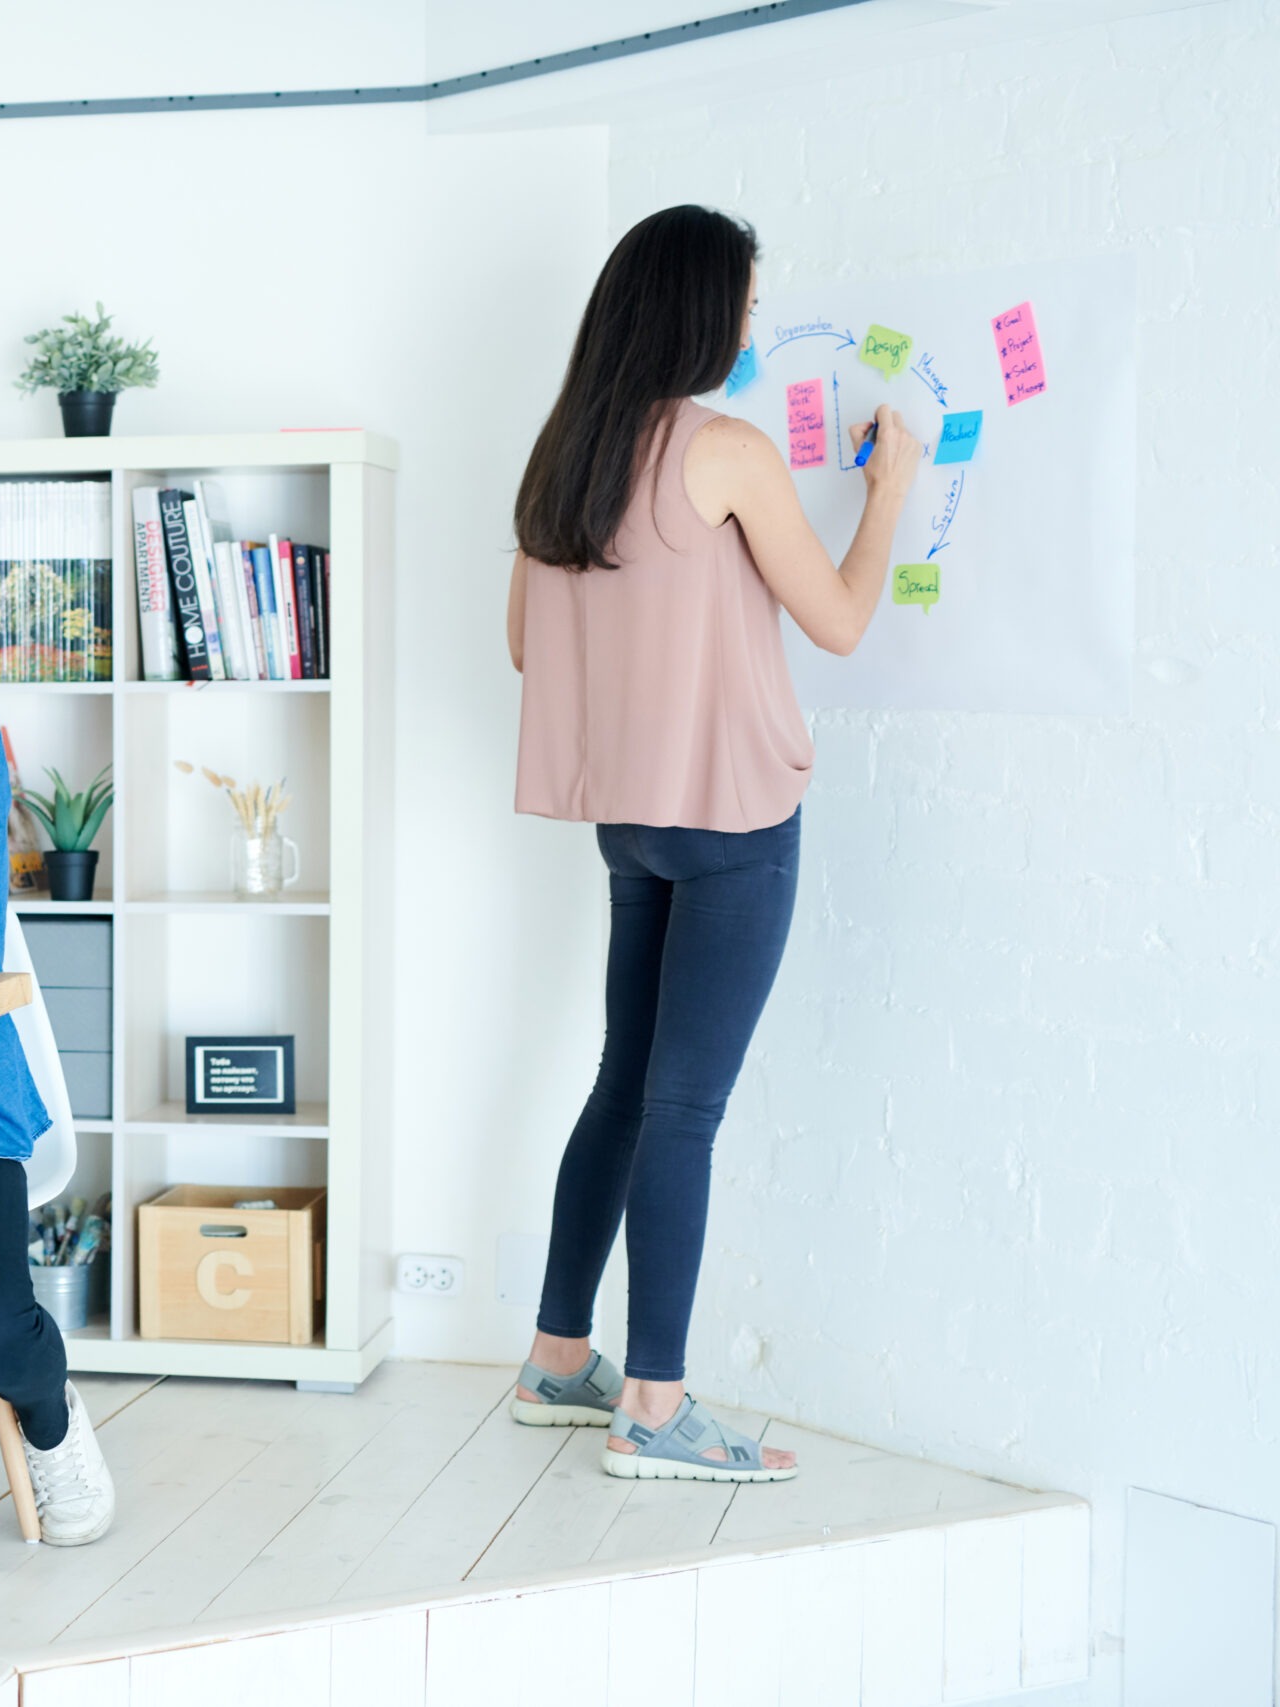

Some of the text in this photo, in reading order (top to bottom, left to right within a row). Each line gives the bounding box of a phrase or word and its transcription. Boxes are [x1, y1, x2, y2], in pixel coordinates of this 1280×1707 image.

[865, 335, 909, 368] Design
[136, 522, 152, 613] APARTMENTS
[145, 520, 166, 613] DESIGNER
[162, 500, 195, 592] COUTURE
[898, 570, 939, 597] Spread
[179, 596, 206, 659] HOME
[196, 1249, 256, 1310] C
